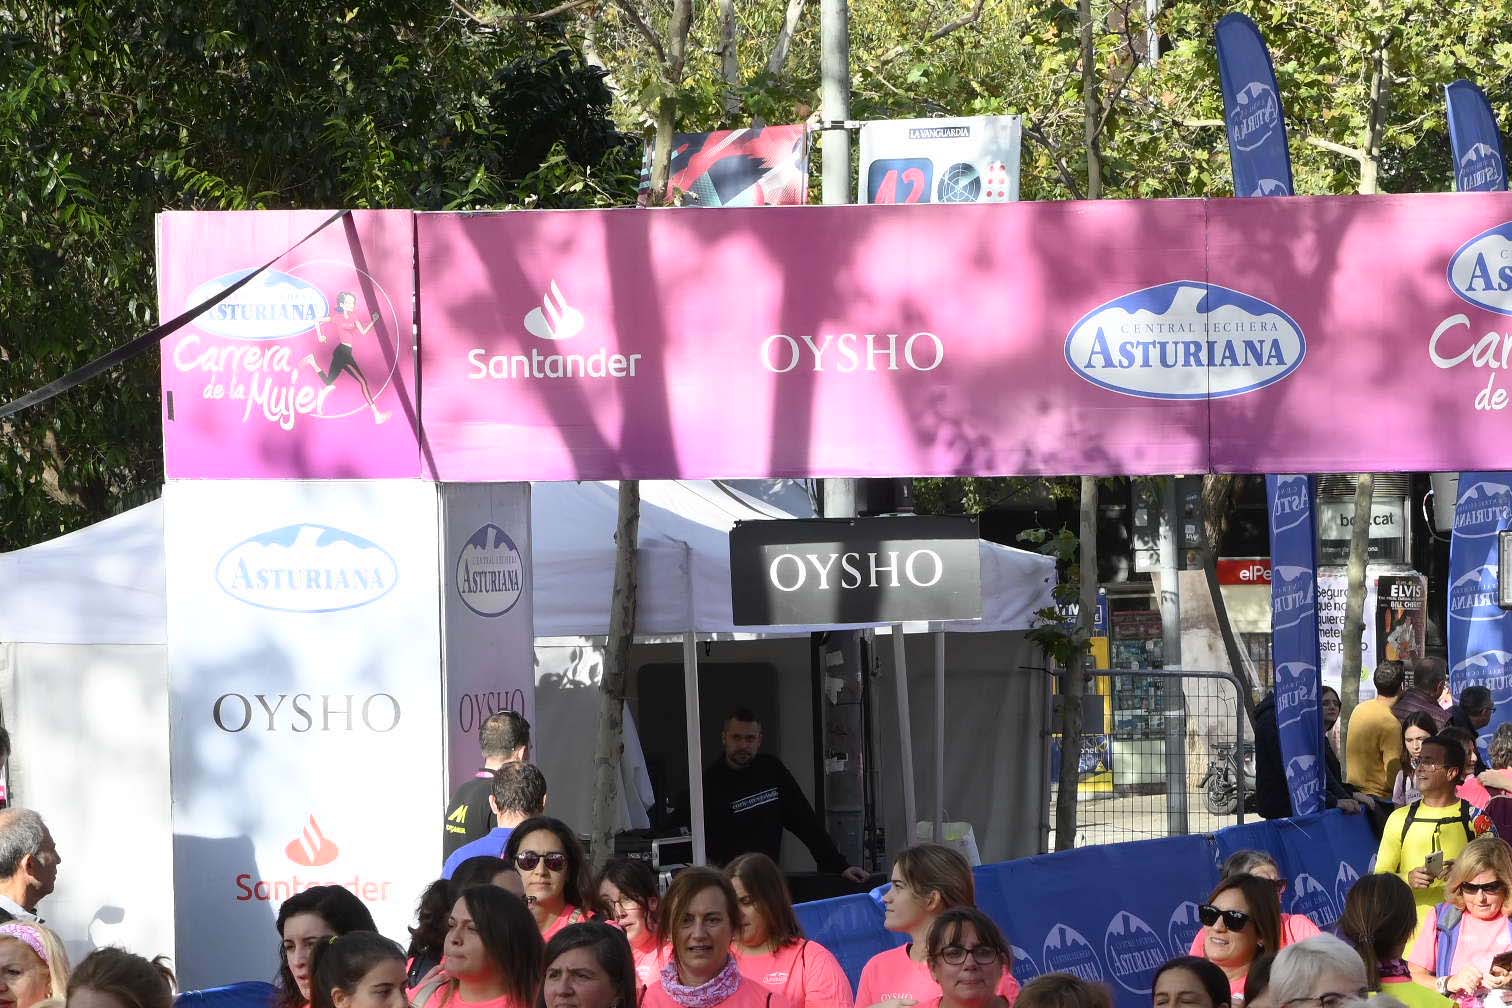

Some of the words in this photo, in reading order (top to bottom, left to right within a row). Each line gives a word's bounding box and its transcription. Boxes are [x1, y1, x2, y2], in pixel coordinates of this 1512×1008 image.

[919, 127, 969, 138] VANGUARDIA
[1120, 321, 1196, 335] CENTRAL
[1204, 321, 1279, 335] LECHERA
[173, 336, 293, 374] Carrera
[468, 348, 641, 379] Santander
[760, 332, 944, 374] OYSHO
[1083, 326, 1288, 369] ASTURIANA
[203, 378, 225, 400] de
[229, 377, 246, 400] la
[243, 367, 337, 431] Mujer
[1474, 371, 1509, 411] de
[231, 556, 386, 591] ASTURIANA
[462, 559, 519, 594] ASTURIANA
[768, 549, 943, 592] OYSHO
[1390, 584, 1421, 597] ELVIS
[212, 692, 401, 733] OYSHO
[1115, 947, 1166, 977] ASTURIANA
